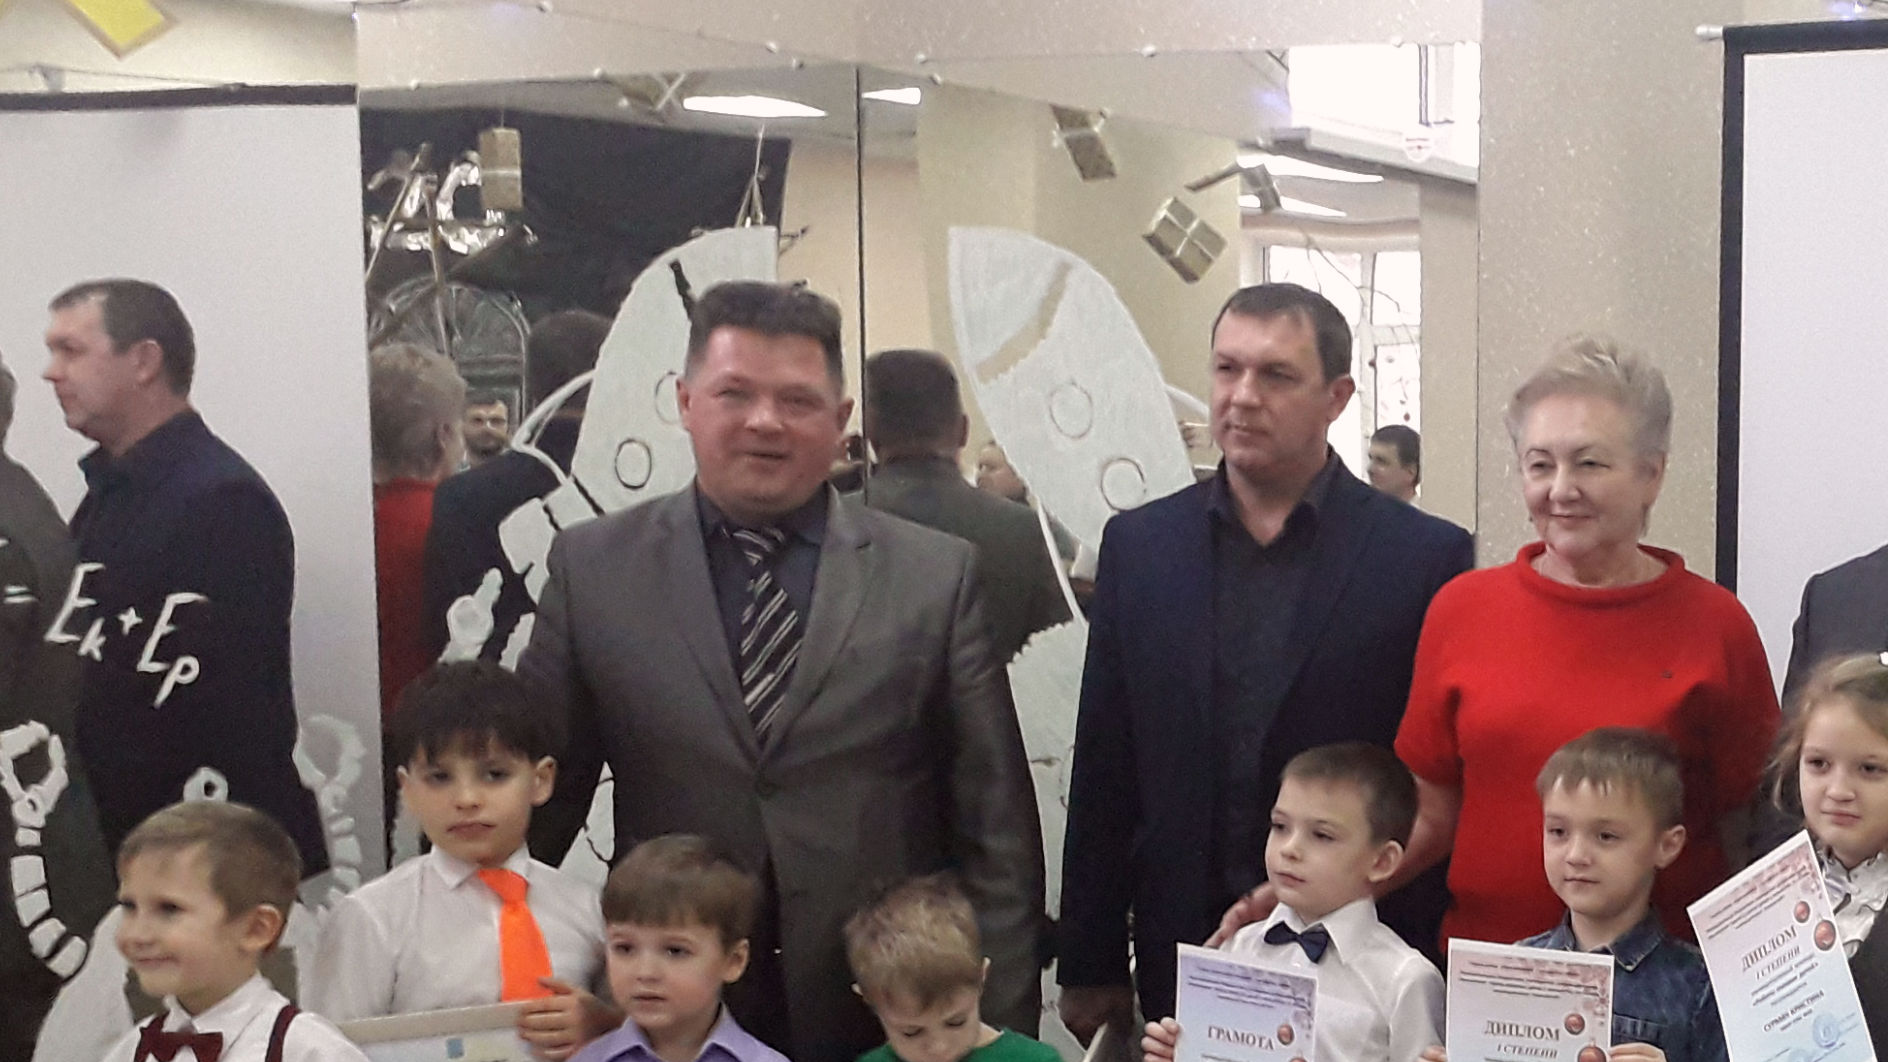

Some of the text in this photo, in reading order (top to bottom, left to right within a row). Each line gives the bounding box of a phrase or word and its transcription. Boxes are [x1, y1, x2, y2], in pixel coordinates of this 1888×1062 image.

[1741, 925, 1798, 972] ДИПЛОМ
[1207, 1025, 1274, 1051] ГРАМОТА
[1484, 1021, 1560, 1041] ДИПЛОМ
